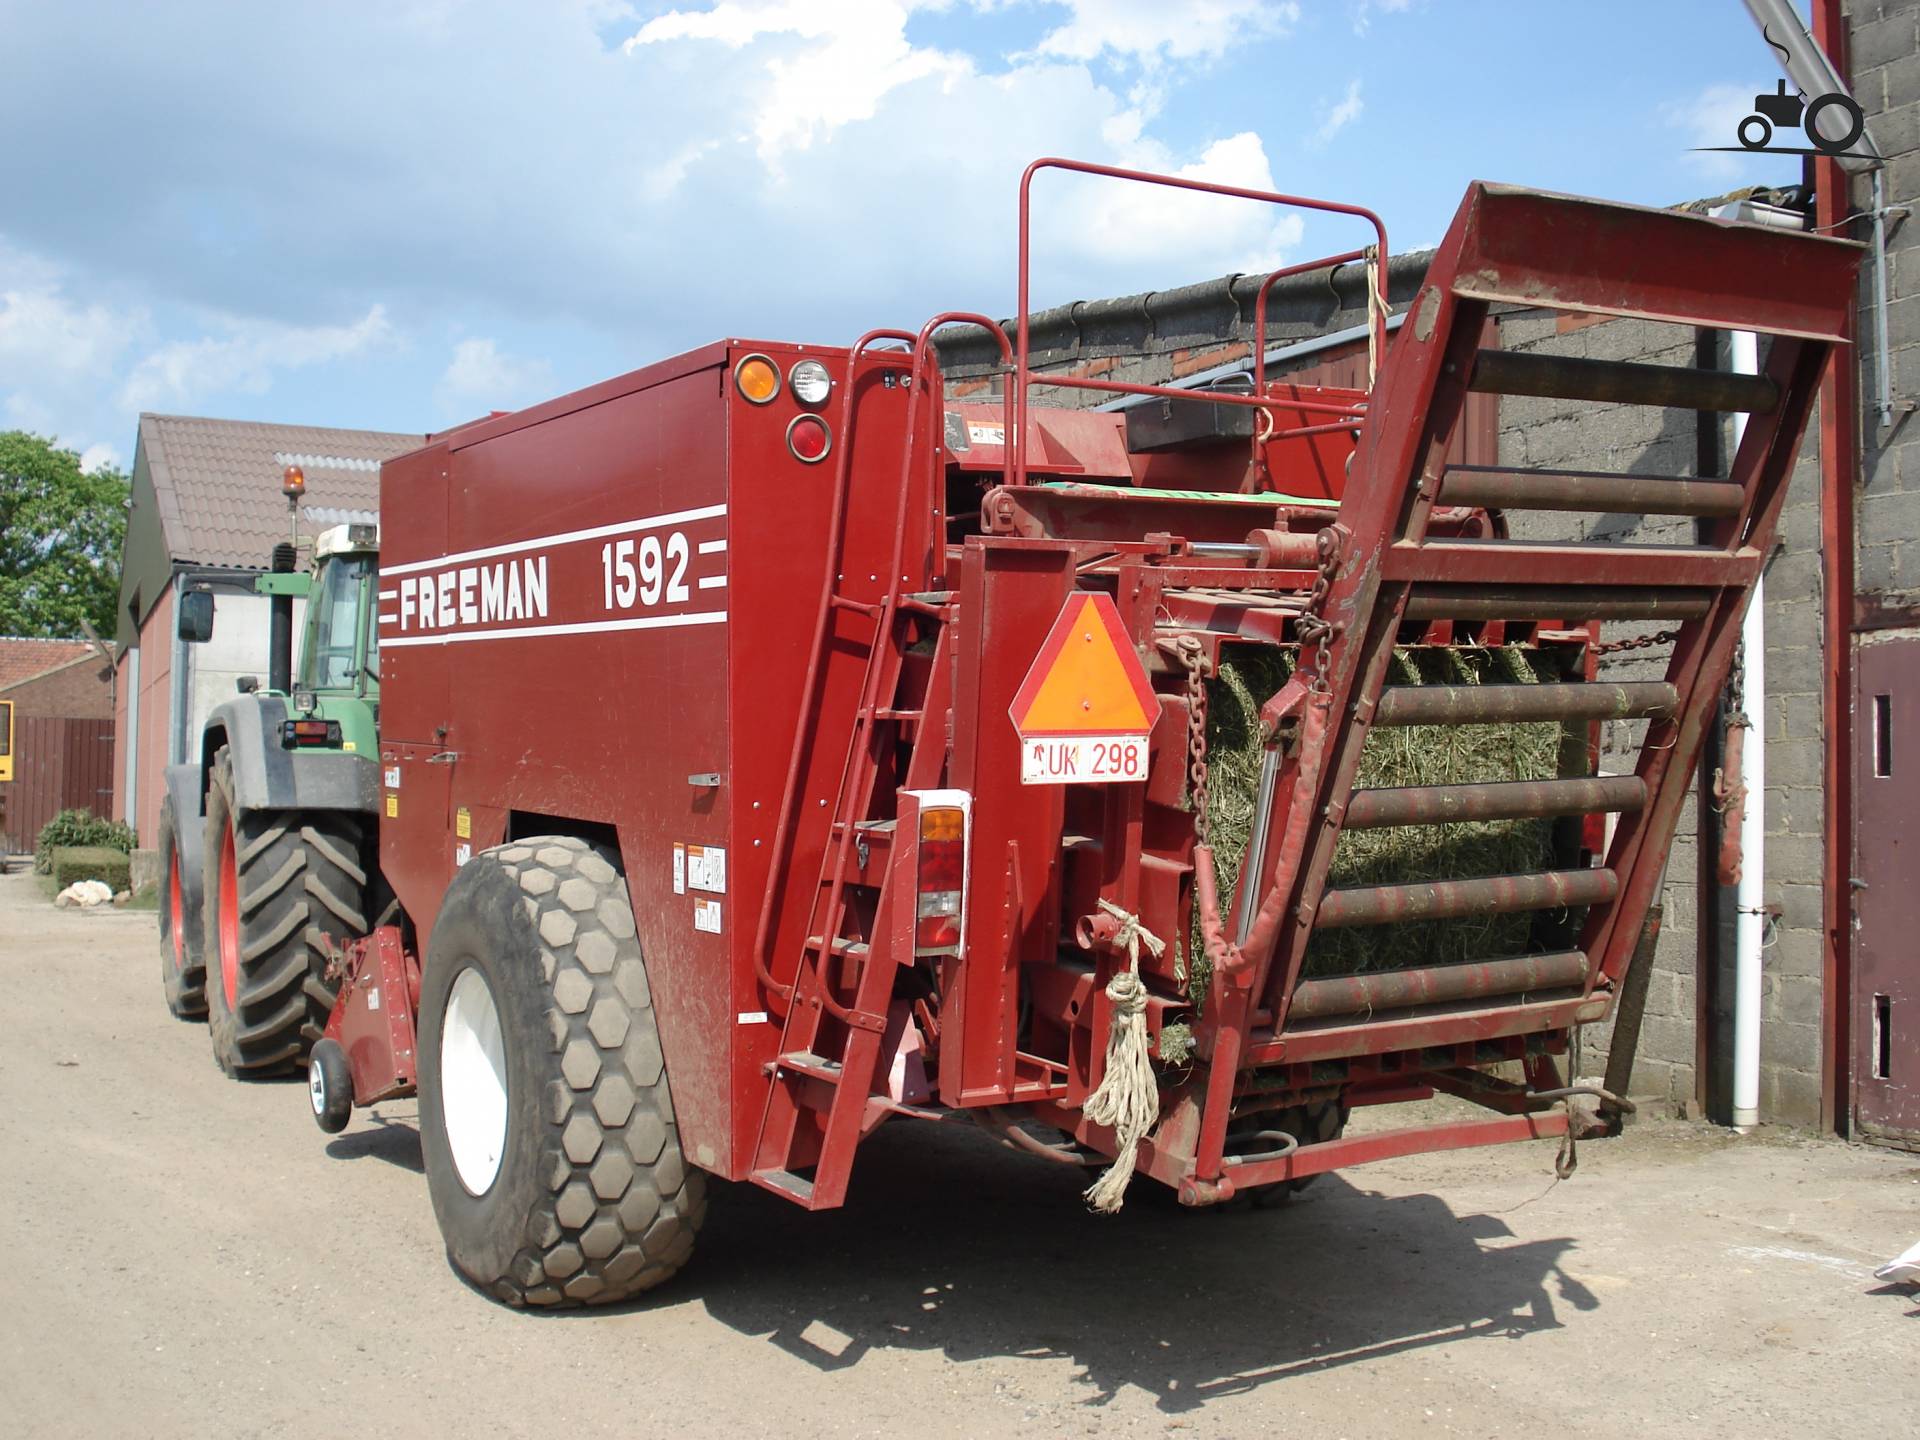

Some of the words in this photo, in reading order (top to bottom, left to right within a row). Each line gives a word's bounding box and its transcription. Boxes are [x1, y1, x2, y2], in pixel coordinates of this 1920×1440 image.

[400, 556, 548, 631] FREEMAN
[602, 532, 690, 609] 1592
[1091, 743, 1139, 776] 298
